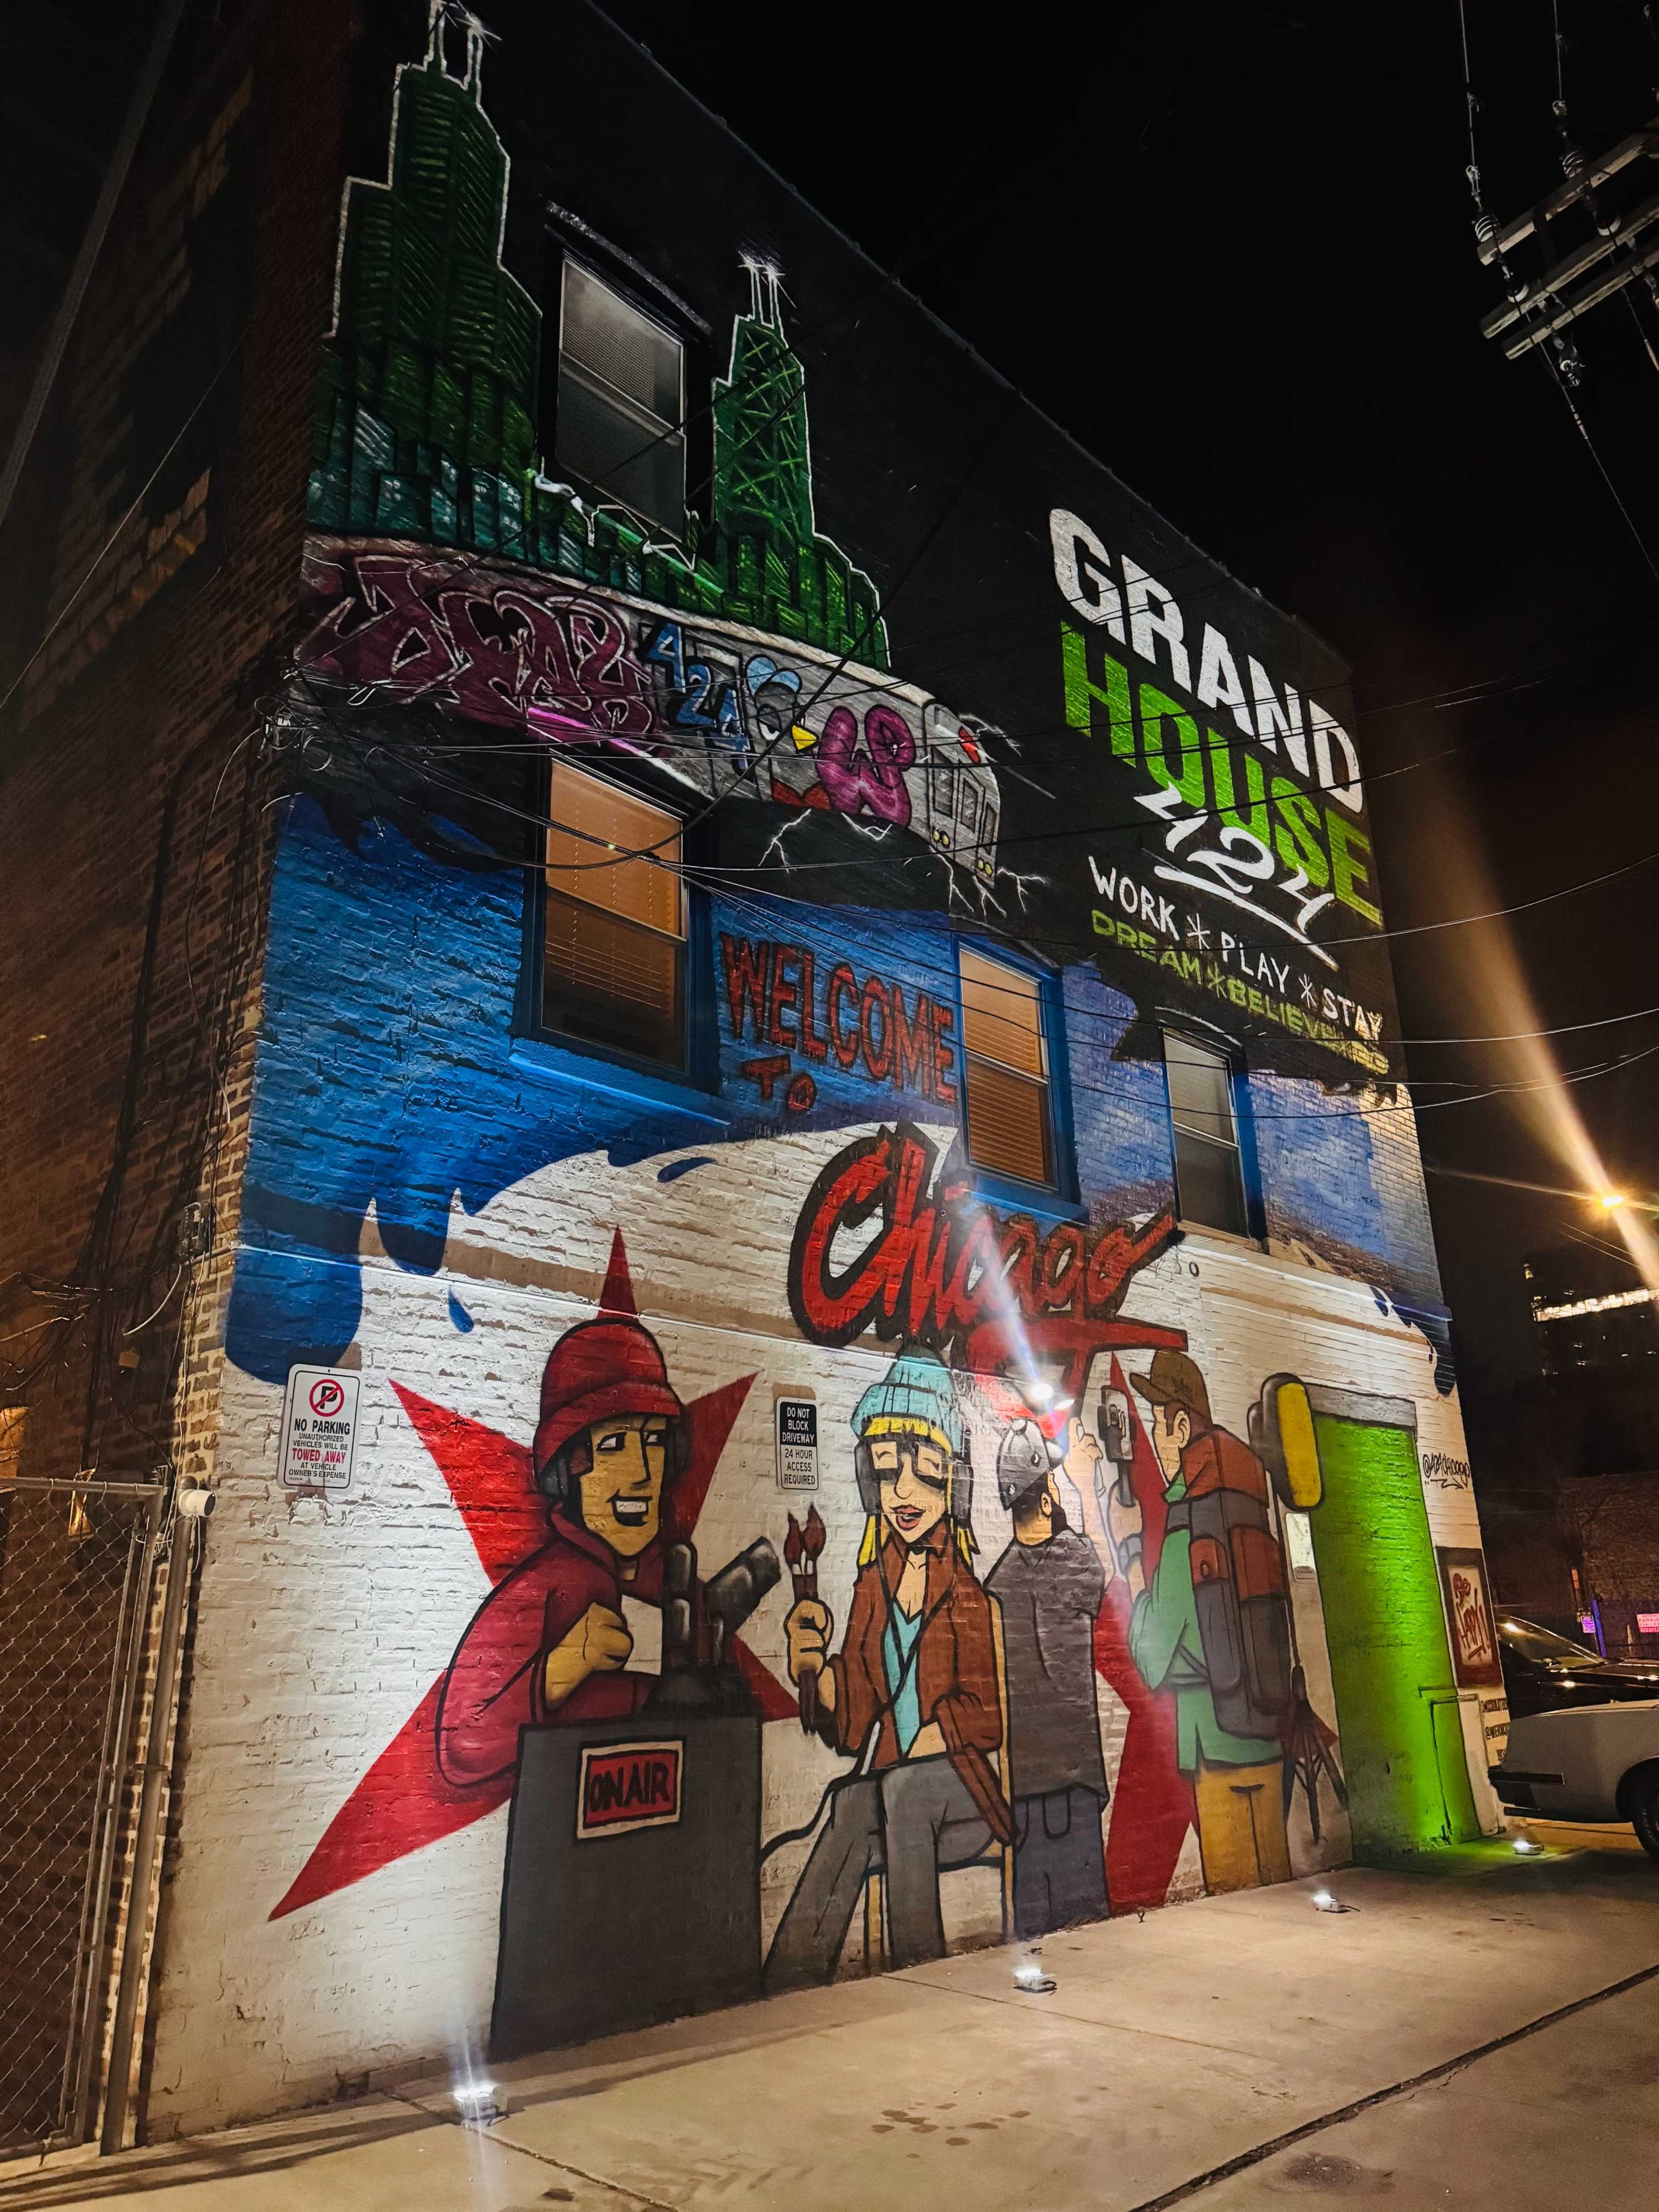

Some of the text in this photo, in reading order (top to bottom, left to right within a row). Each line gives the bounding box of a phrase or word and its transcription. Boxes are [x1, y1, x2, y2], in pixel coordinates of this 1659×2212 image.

[1049, 508, 1363, 813] GRAND
[647, 622, 749, 774] 424
[1061, 621, 1383, 928] HOUSE
[1134, 782, 1335, 935] 424
[1088, 855, 1383, 1041] WORK PLAY STAY
[1092, 910, 1202, 985] DREAM
[719, 931, 959, 1105] WELCOME
[741, 1053, 817, 1115] TO
[787, 1407, 810, 1418] DO NOT
[294, 1418, 350, 1435] NO PARKING
[788, 1420, 809, 1431] BLOCK
[293, 1440, 322, 1448] VEHICLES
[324, 1442, 338, 1450] WILL
[299, 1432, 344, 1442] UNAUTHORIZED
[782, 1432, 815, 1444] DRIVEWAY
[292, 1448, 346, 1464] TOWED AWAY
[785, 1448, 813, 1460] 24 HOUR
[289, 1469, 346, 1479] OWNER'S EXPENSE
[787, 1462, 812, 1472] ACCESS
[784, 1474, 816, 1485] REQUIRED
[589, 1760, 671, 1812] ON AIR
